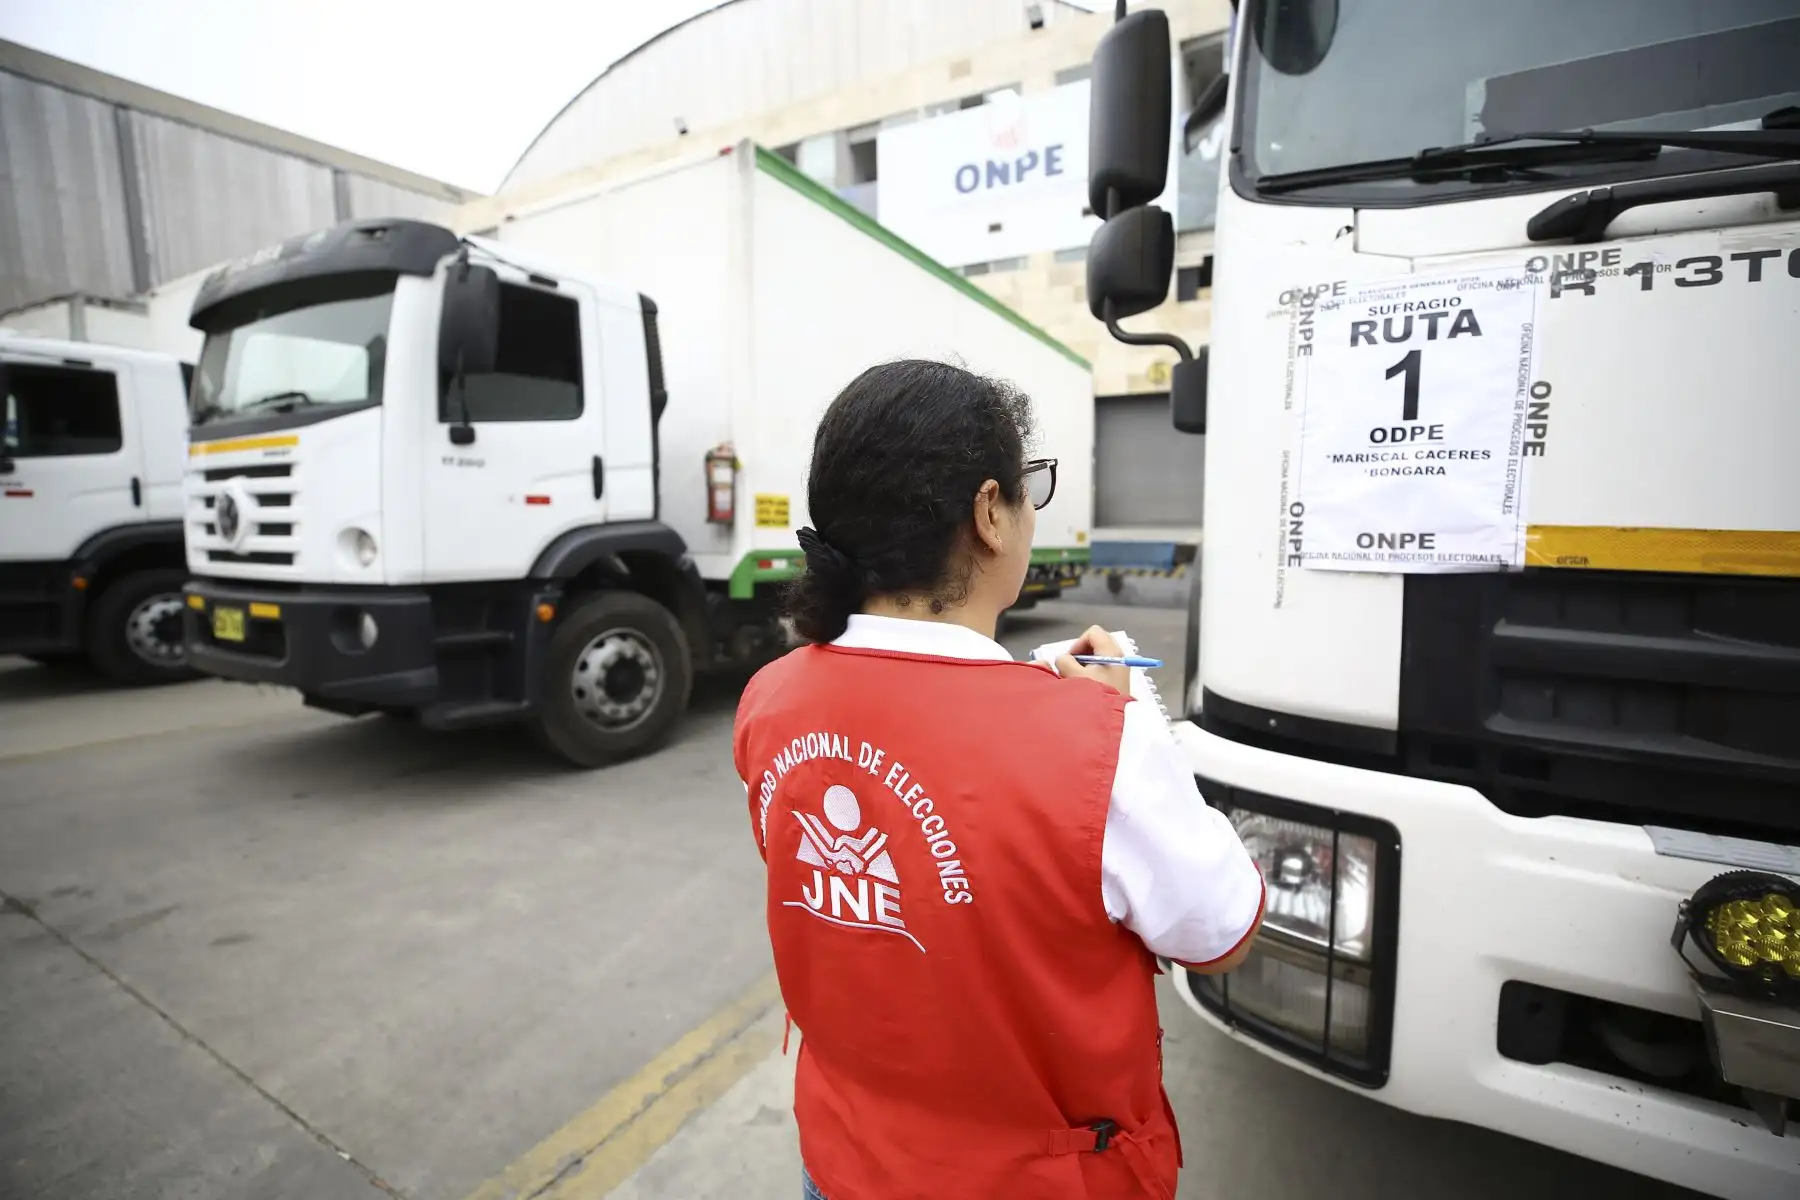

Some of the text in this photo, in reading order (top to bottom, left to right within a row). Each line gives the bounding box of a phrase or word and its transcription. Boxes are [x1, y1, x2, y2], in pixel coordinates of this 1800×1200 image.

[955, 143, 1064, 194] ONPE
[1524, 247, 1622, 274] ONPE
[1624, 247, 1800, 292] 13T
[1297, 292, 1315, 358] ONPE
[1350, 308, 1483, 348] RUTA
[1368, 296, 1462, 317] SUFRAGIO
[1385, 349, 1422, 421] 1
[1514, 400, 1525, 411] DE
[1369, 424, 1444, 444] ODPE
[1508, 413, 1523, 457] PROCESOS
[1522, 380, 1552, 458] ONPE
[1414, 449, 1491, 461] CACERES
[1501, 458, 1519, 516] ELECTORALES
[1287, 501, 1305, 568] ONPE
[1356, 532, 1436, 550] ONPE
[1331, 551, 1372, 561] NACIONAL
[1388, 552, 1434, 562] PROCESOS
[1437, 552, 1502, 563] ELECTORALES
[773, 732, 853, 779] NACIONAL
[857, 741, 886, 776] DE
[883, 761, 974, 905] ELECCIONES
[802, 869, 906, 929] JNE
